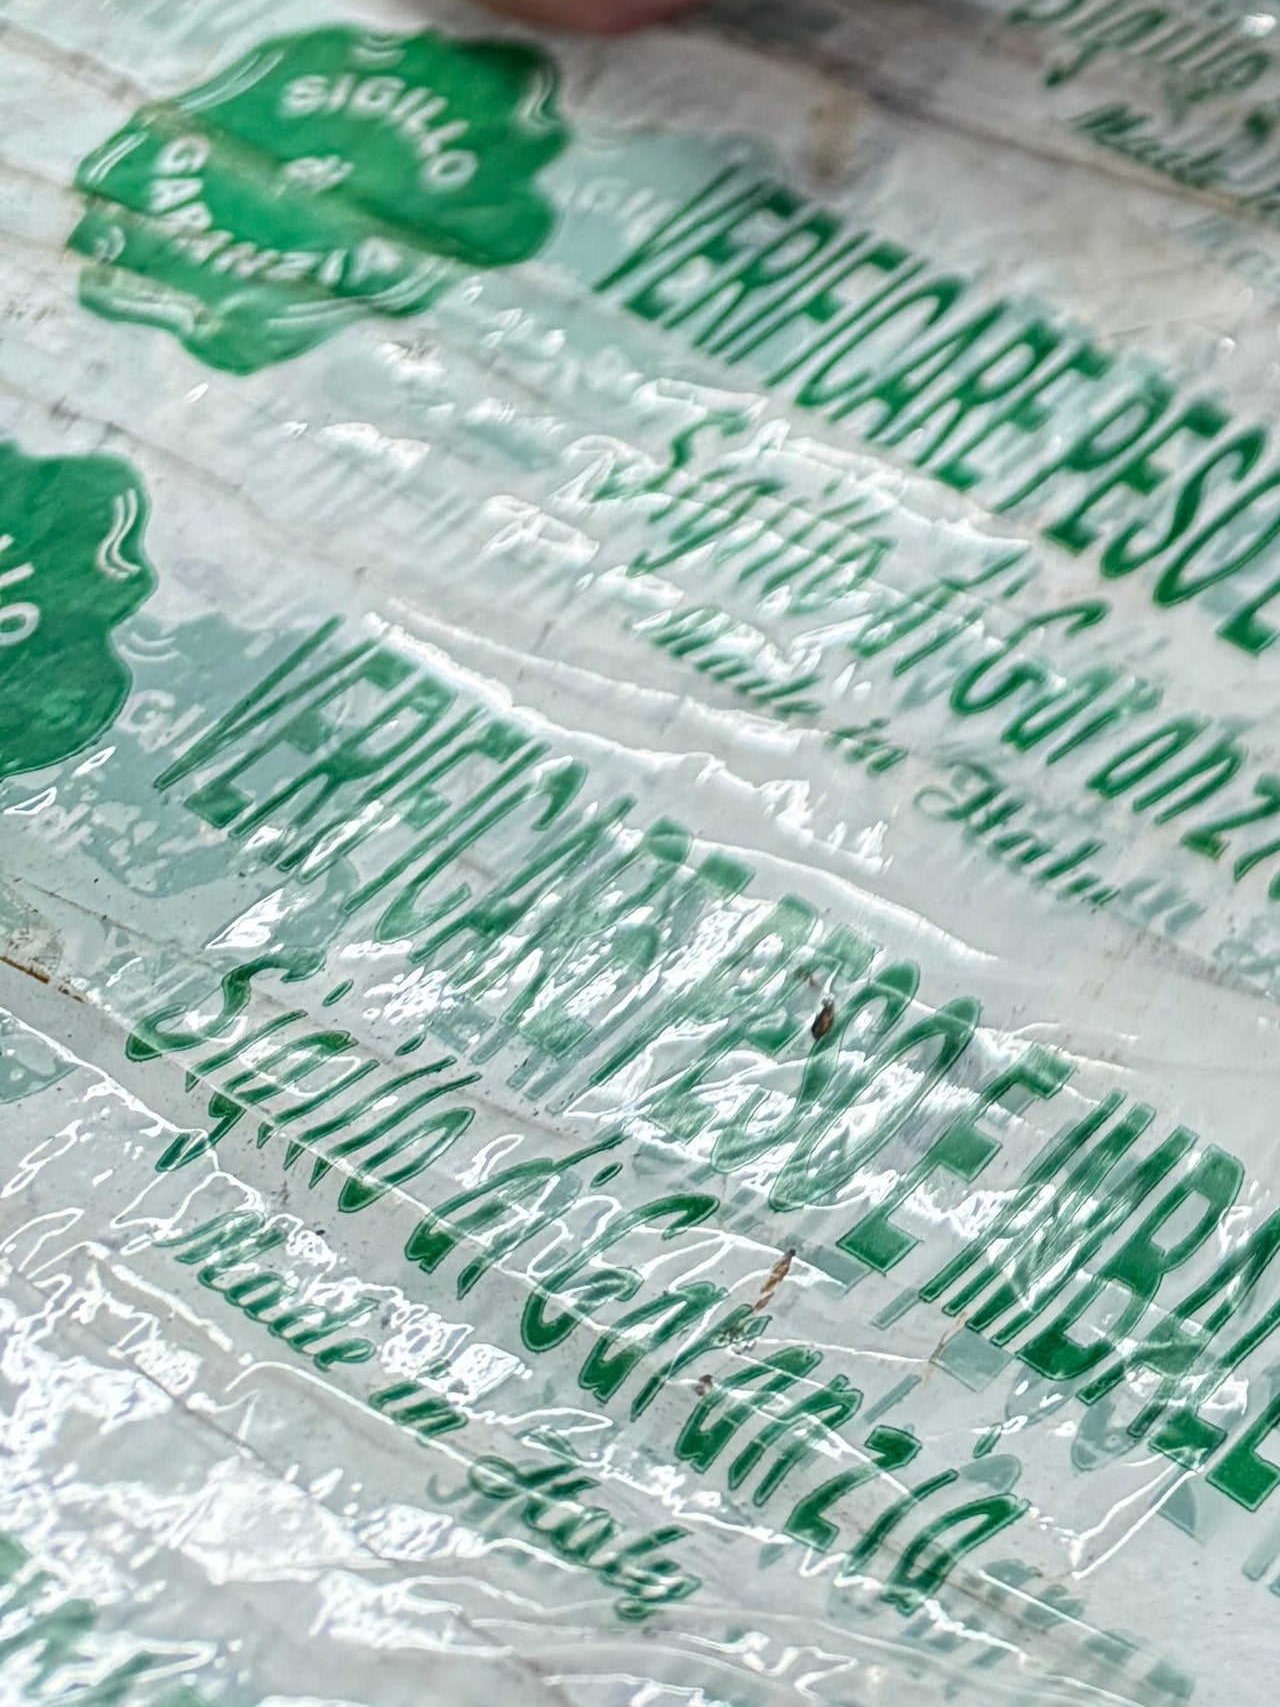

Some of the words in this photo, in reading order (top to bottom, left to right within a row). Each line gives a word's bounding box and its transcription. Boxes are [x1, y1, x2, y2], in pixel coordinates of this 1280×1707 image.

[277, 74, 480, 187] SIGILLO
[592, 161, 1112, 489] VERIFICARE
[152, 612, 755, 1060] VERIFICARE
[588, 892, 982, 1213] PESO
[836, 1040, 1078, 1276] E
[125, 945, 483, 1213] Sigillo
[518, 1192, 1032, 1618] Garanzia
